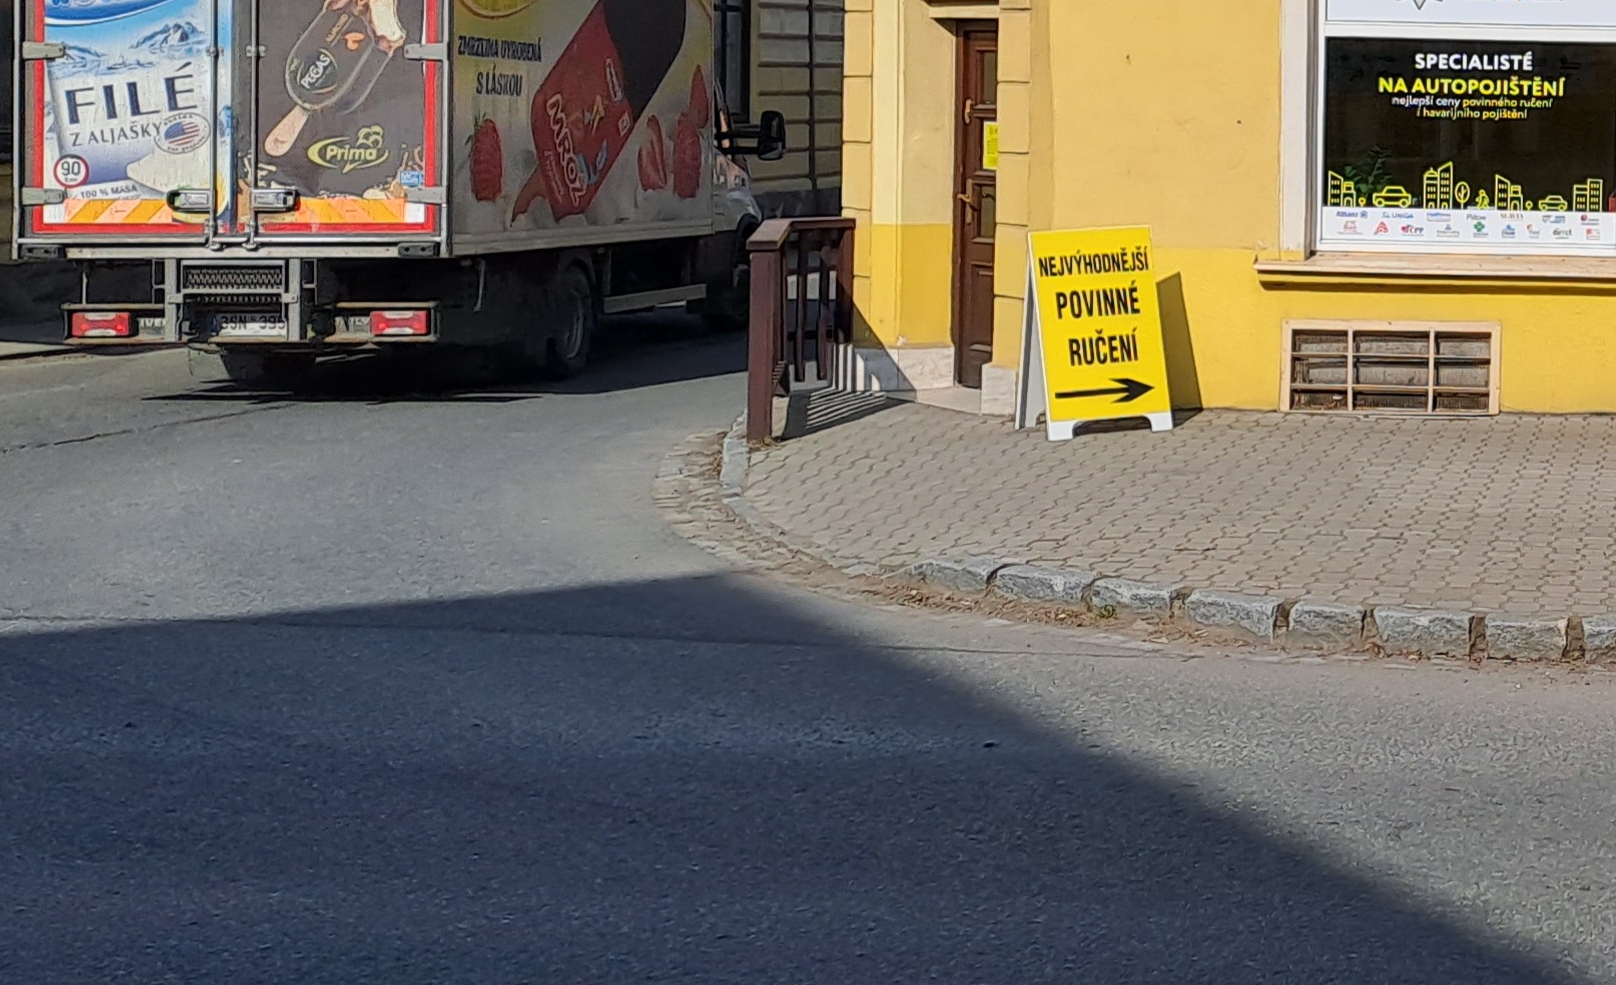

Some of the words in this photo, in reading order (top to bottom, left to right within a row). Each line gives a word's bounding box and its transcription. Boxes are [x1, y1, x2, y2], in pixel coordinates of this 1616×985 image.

[1414, 51, 1534, 71] SPECIALISTÉ
[475, 71, 484, 95] S
[485, 62, 523, 97] LÁSKOU
[1378, 77, 1408, 94] NA
[1411, 75, 1566, 97] AUTOPOJIŠTĚNÍ
[64, 61, 198, 125] FILÉ
[1391, 95, 1435, 108] nejlepší
[1435, 98, 1461, 109] ceny
[1462, 98, 1518, 110] povinného
[1519, 98, 1554, 109] ručení
[1482, 108, 1528, 122] pojištění
[69, 131, 83, 148] Z
[87, 120, 163, 145] ALJAŠKY
[325, 144, 378, 161] Prima
[61, 160, 81, 176] 90
[80, 189, 98, 199] 100
[1038, 245, 1149, 278] NEJVÝHODNĚJŠÍ
[1055, 279, 1141, 320] POVINNÉ
[1068, 326, 1139, 366] RUČENÍ
